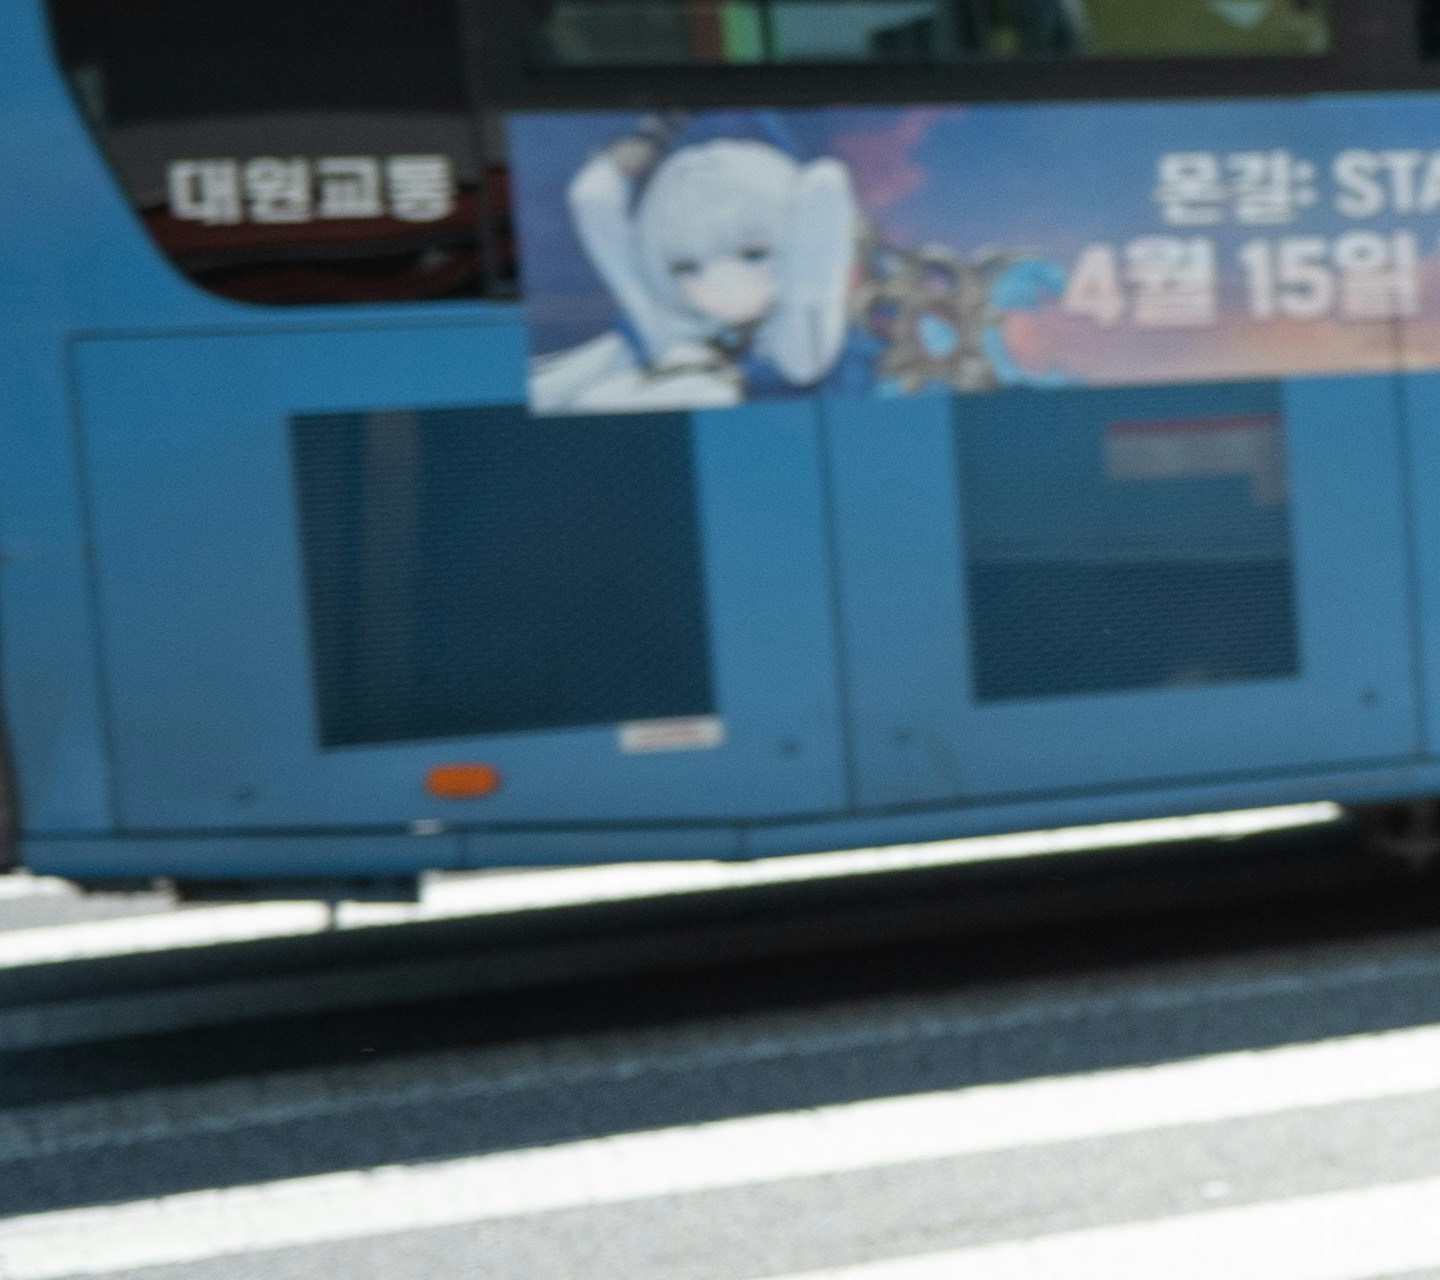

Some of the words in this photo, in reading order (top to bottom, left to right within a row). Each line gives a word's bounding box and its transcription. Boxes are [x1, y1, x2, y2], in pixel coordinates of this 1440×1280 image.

[166, 153, 456, 227] 대원교통
[1064, 236, 1217, 321] 4월
[1242, 228, 1421, 319] 15일
